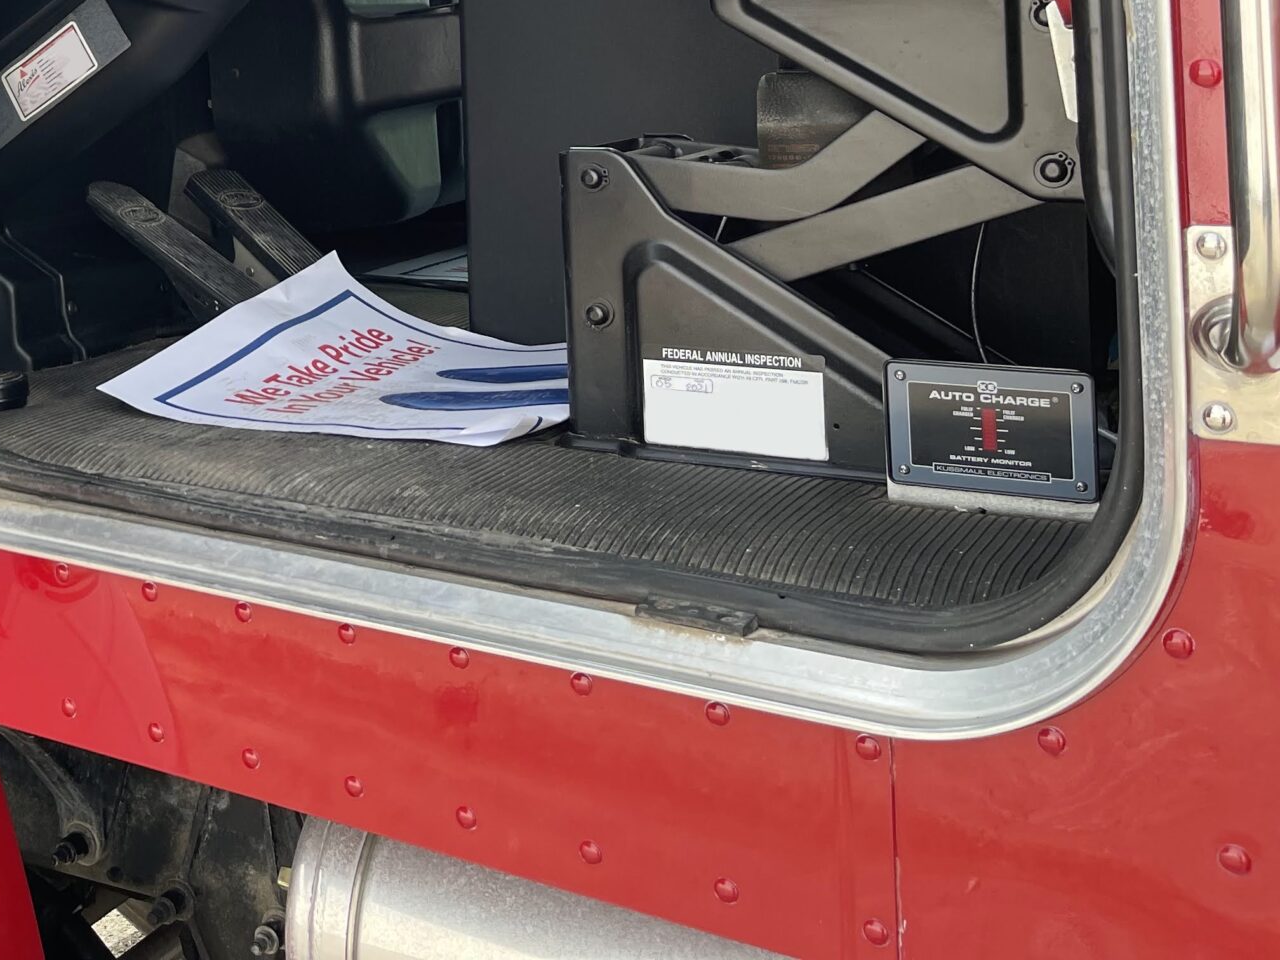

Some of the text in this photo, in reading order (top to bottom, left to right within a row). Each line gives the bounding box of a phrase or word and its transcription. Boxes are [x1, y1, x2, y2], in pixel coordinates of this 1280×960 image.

[224, 328, 394, 405] We Take Pride
[662, 347, 803, 368] FEDERAL ANNUAL INSPECTION
[266, 339, 441, 414] In Your Vehicle!
[929, 390, 1051, 408] AUTO CHARGE
[949, 454, 1032, 467] BATTERY MONITOR
[936, 465, 1047, 481] KUSSMAUL ELECTRONICS
